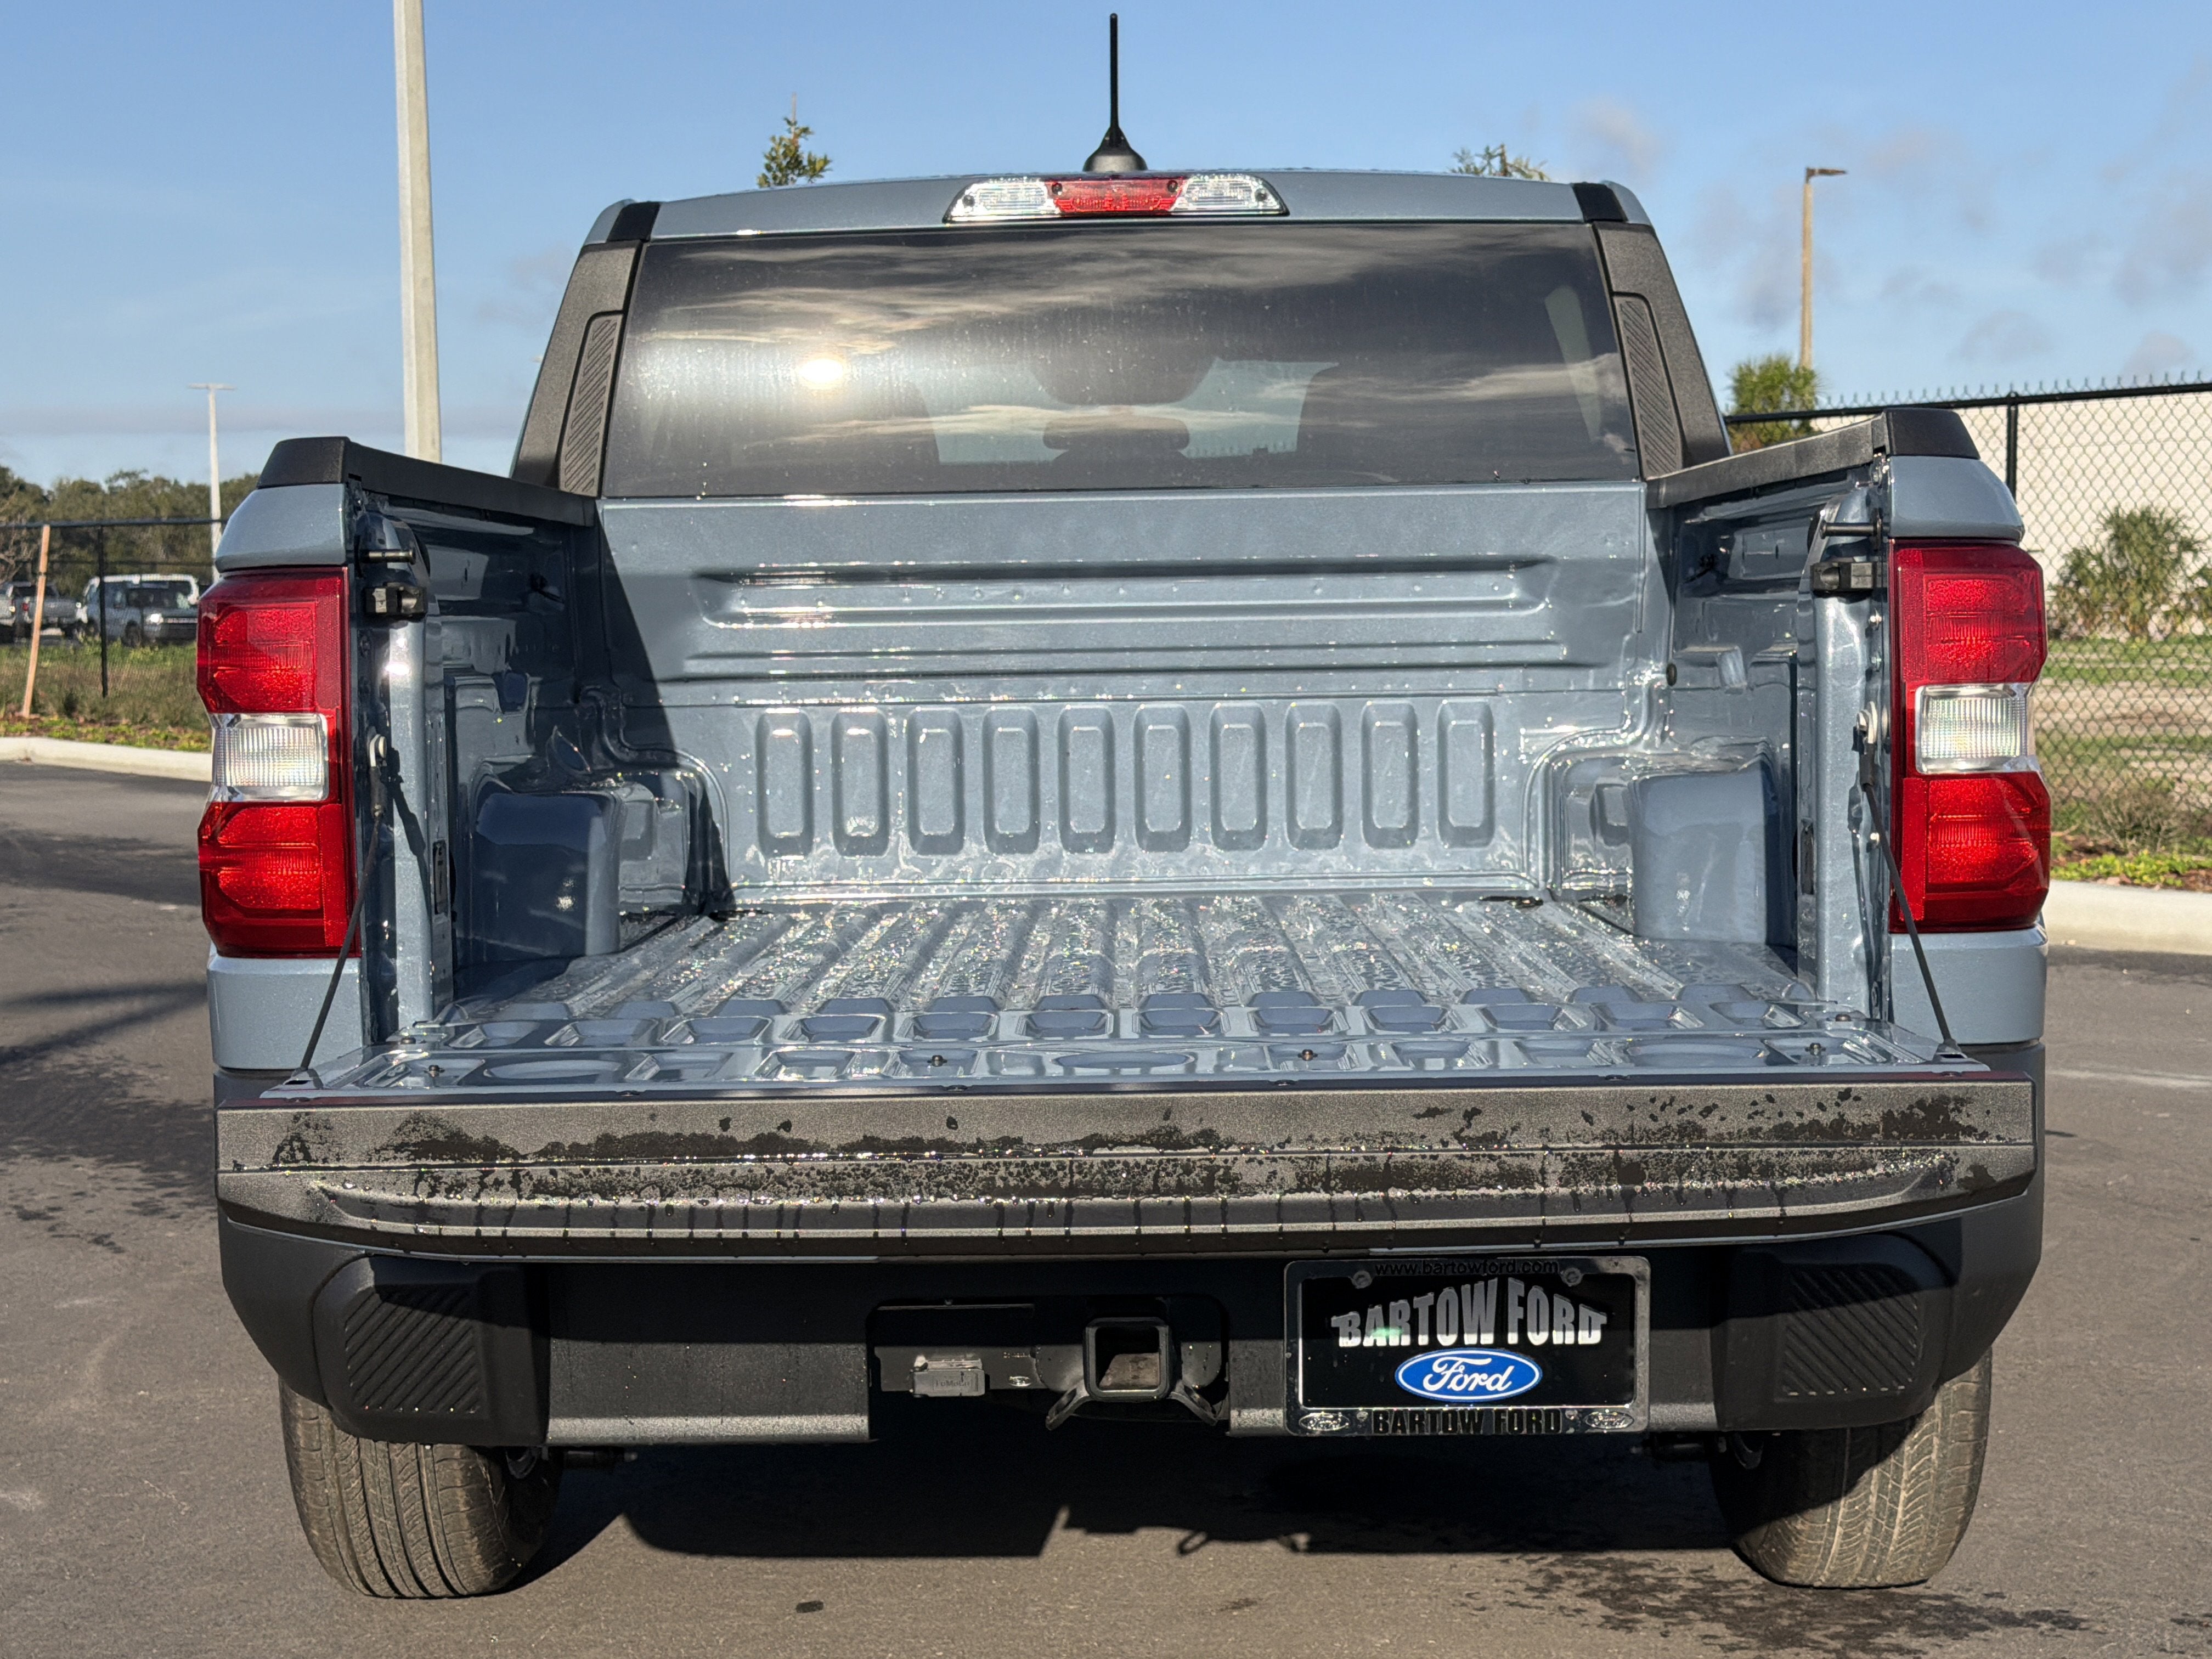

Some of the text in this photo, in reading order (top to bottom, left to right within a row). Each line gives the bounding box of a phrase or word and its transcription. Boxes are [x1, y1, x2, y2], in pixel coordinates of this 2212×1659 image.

[1375, 1260, 1559, 1276] www.bartowford.com
[1331, 1277, 1607, 1347] BARTOW FORD
[1423, 1356, 1515, 1392] Ford
[1373, 1408, 1561, 1434] BARTOW FORD
